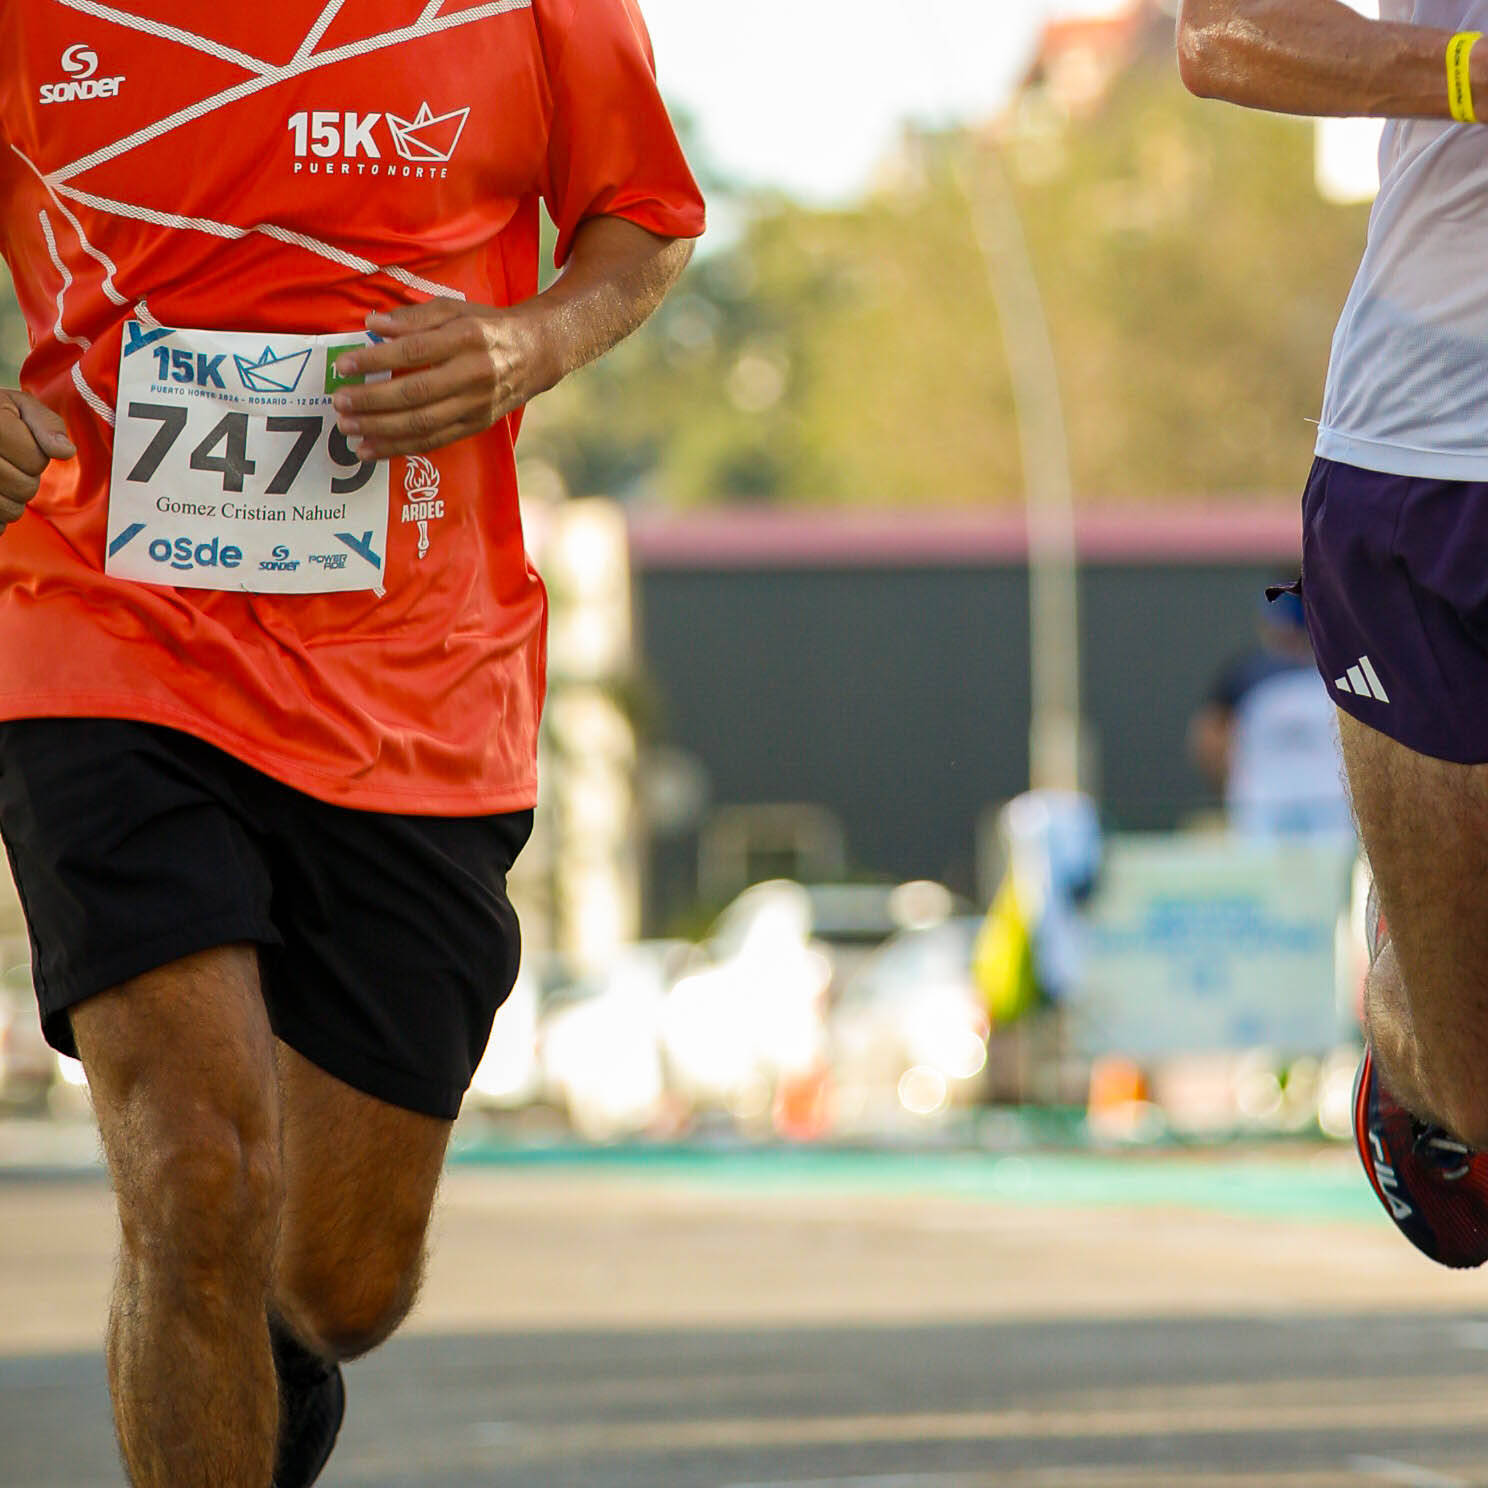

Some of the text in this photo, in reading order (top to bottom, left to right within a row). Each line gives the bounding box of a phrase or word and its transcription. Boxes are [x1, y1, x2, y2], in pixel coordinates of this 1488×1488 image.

[288, 111, 382, 158] 15K
[293, 163, 448, 178] PUERTO NORTE
[152, 345, 228, 389] 15K
[150, 384, 185, 395] PUERTO
[248, 396, 288, 406] ROSARIO
[126, 401, 379, 495] 7479
[155, 495, 347, 522] Gomez Cristian Nahuel
[401, 499, 445, 524] ARDEC
[148, 536, 243, 570] osde
